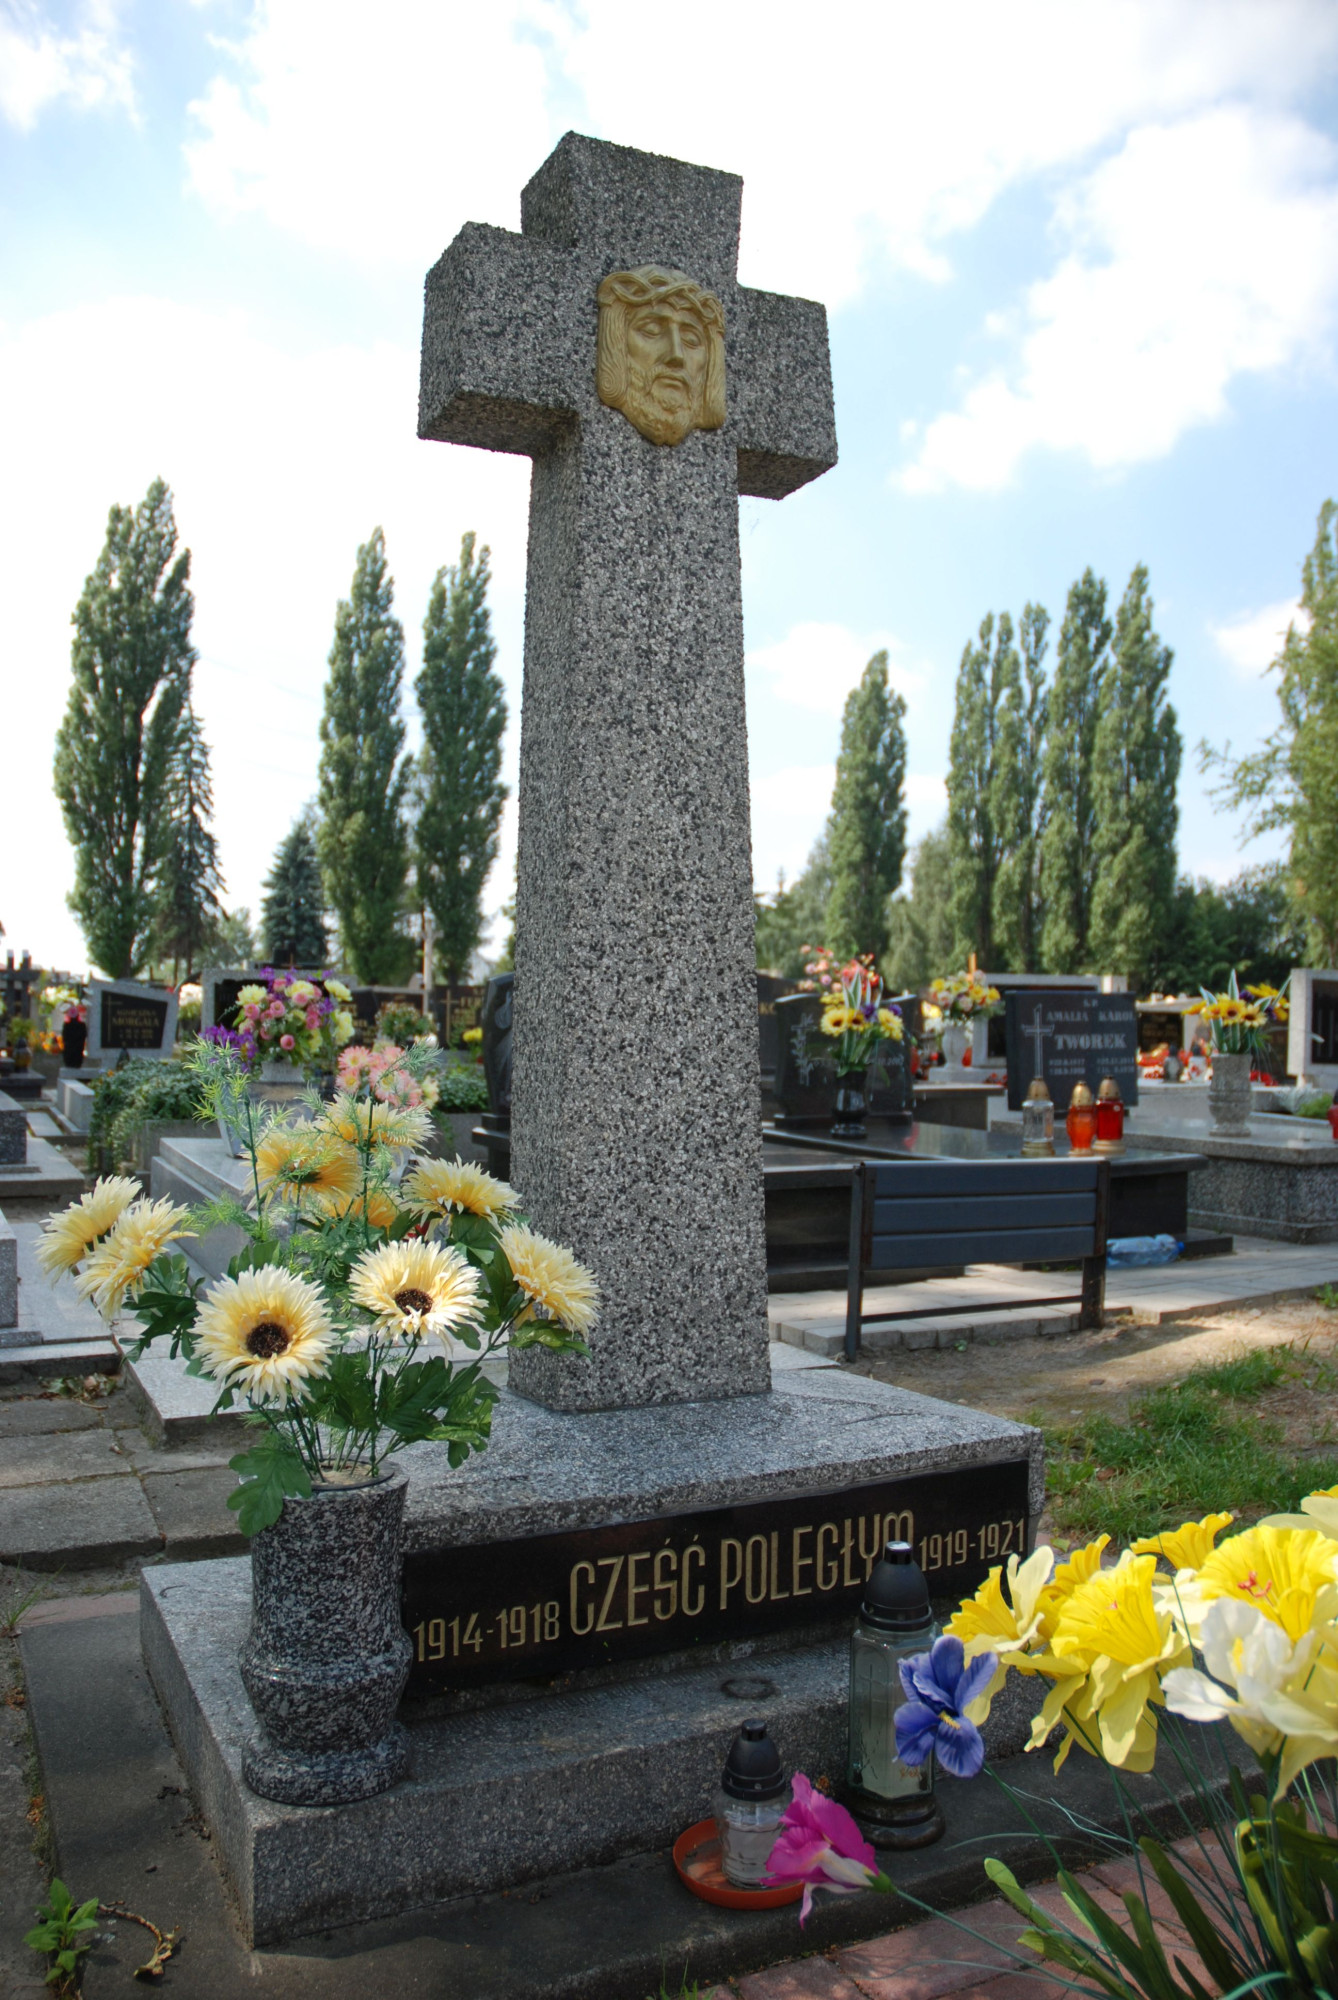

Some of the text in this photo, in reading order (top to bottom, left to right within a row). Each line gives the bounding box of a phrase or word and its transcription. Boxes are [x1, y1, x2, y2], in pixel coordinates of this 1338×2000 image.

[1046, 1010, 1135, 1022] AMALIA KAROL
[1054, 1033, 1127, 1050] TWOREK
[413, 1509, 1025, 1662] 1914-1918 CZEŚĆ POLEGŁYM 1919-1921
